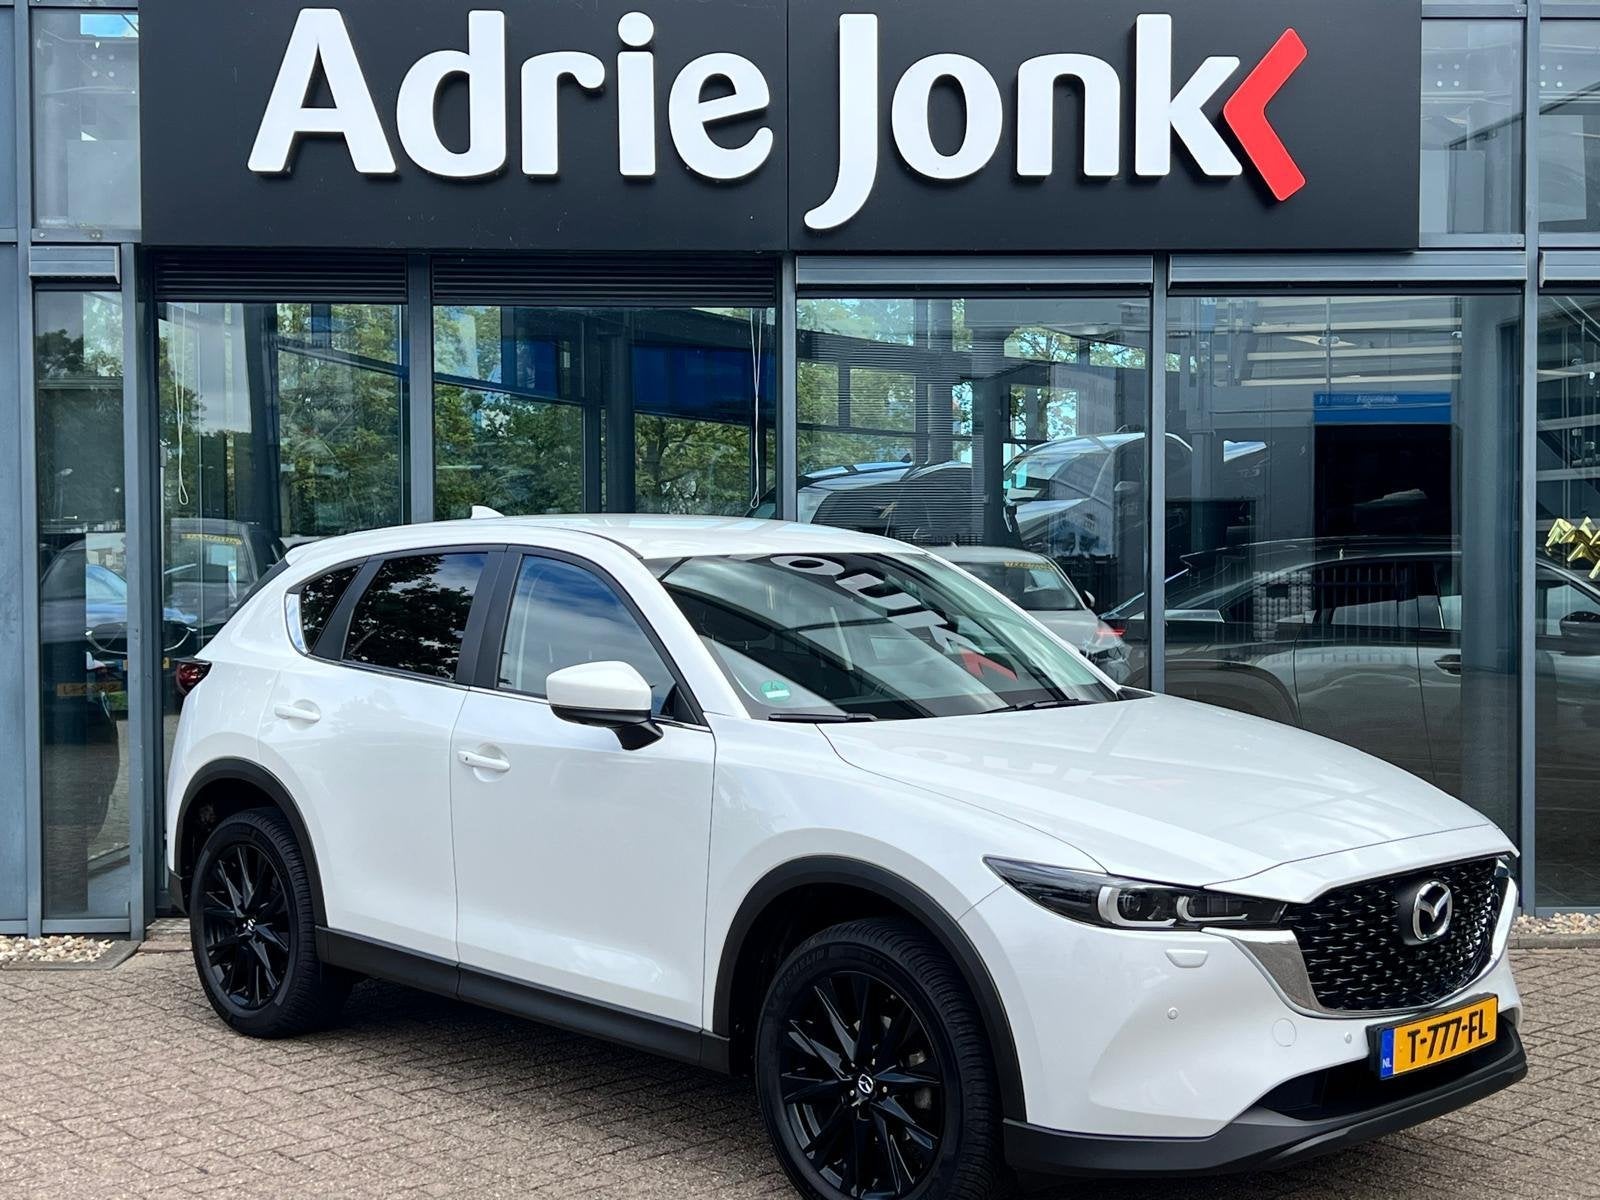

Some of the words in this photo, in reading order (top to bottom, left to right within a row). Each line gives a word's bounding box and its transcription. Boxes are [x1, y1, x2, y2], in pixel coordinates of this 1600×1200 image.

[247, 7, 774, 180] Adrie
[803, 13, 1243, 230] Jonk
[1382, 1057, 1392, 1069] NL
[1407, 1008, 1488, 1063] T-777-FL
